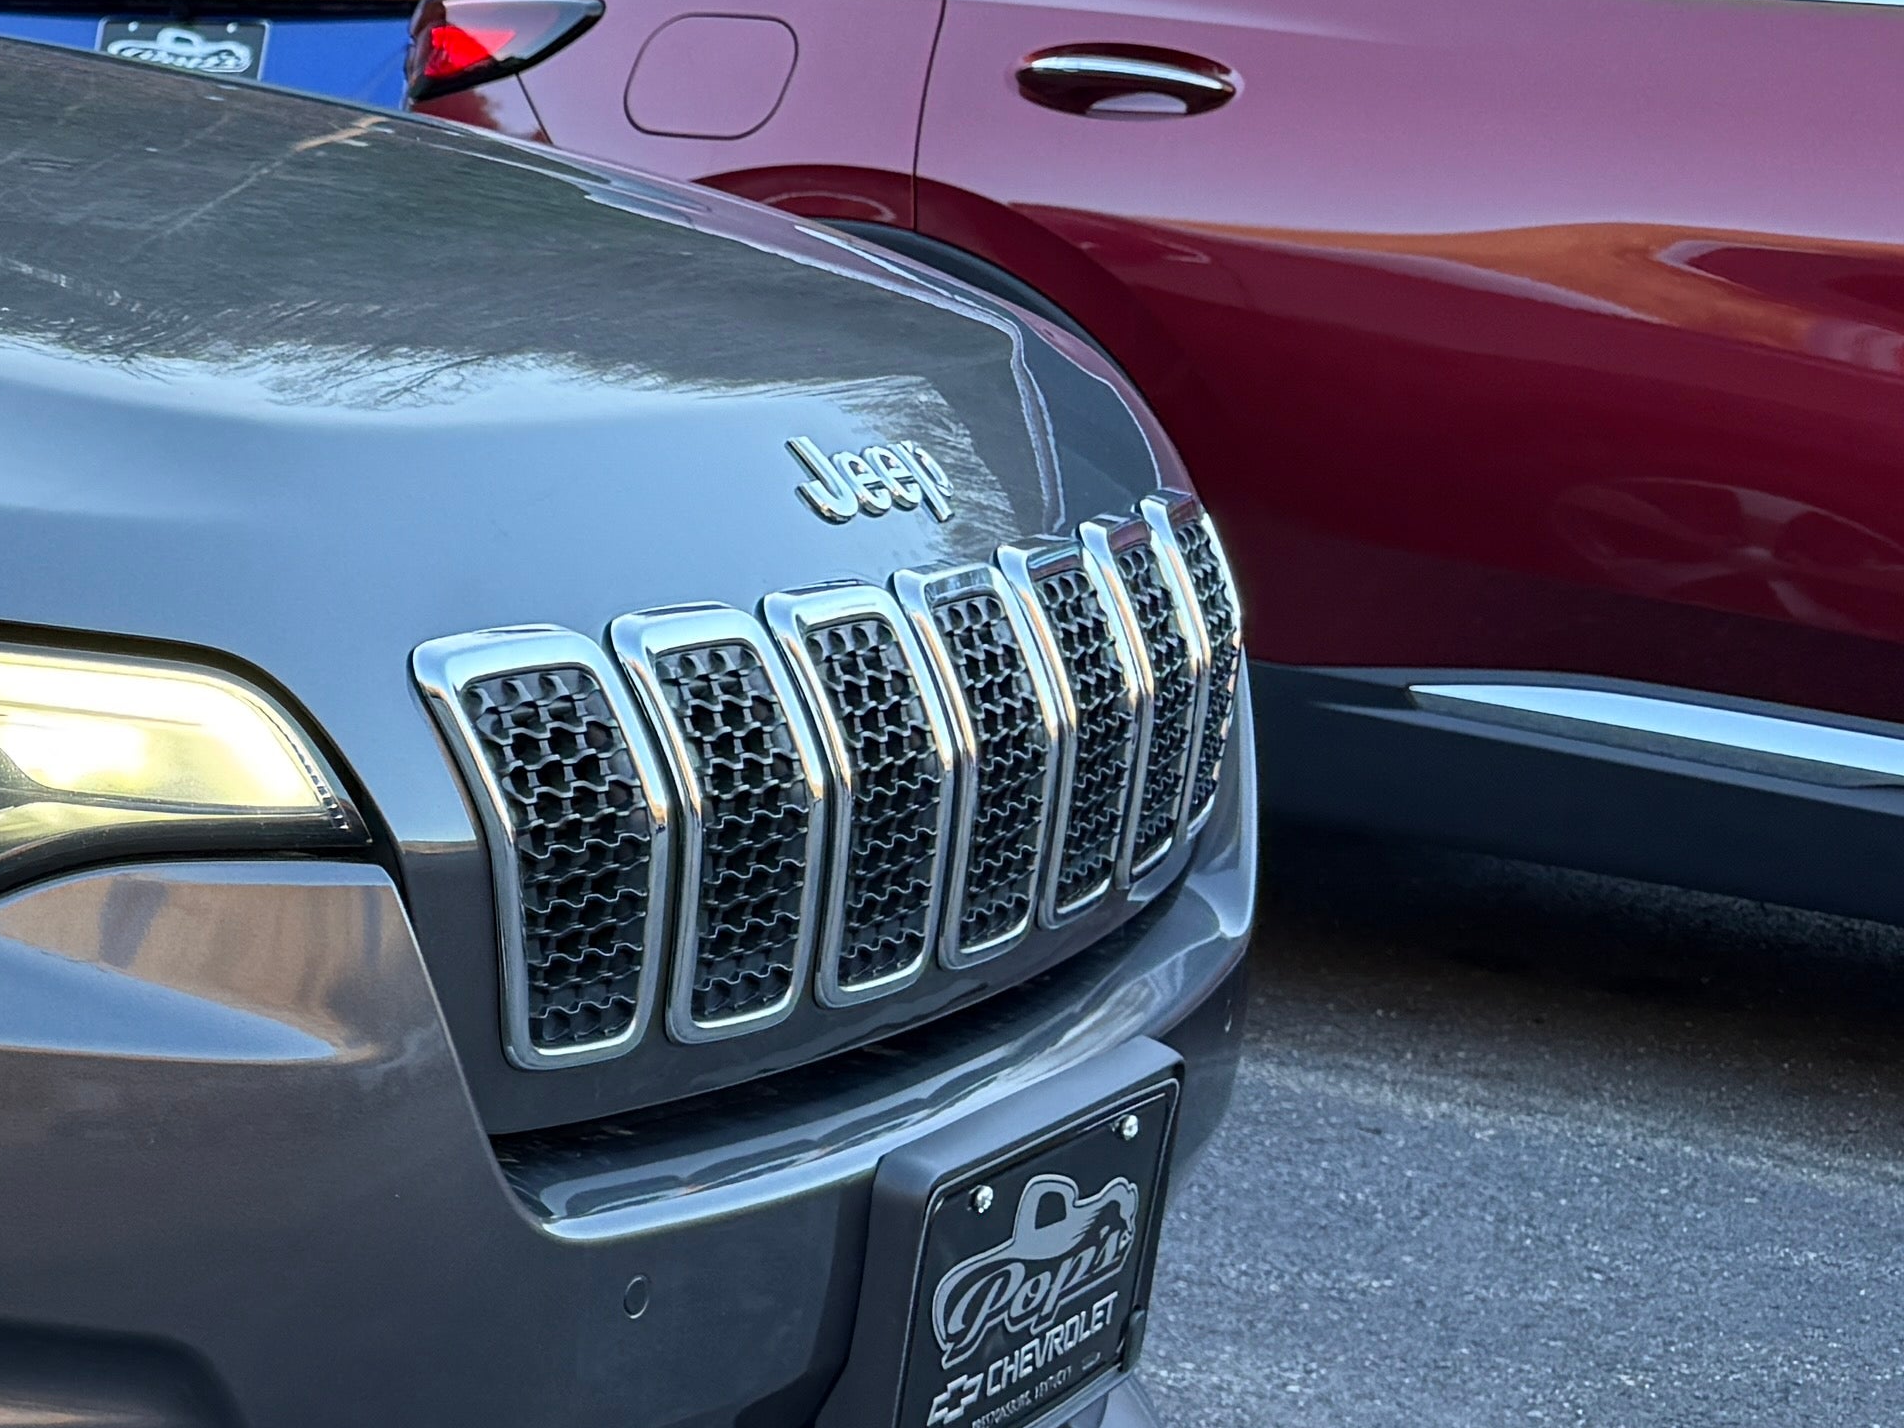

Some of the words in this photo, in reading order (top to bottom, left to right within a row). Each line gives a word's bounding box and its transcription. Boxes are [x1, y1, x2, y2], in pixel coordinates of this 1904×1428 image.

[784, 436, 955, 524] Jeep
[946, 1225, 1125, 1350] Pop's
[986, 1290, 1119, 1398] CHEVROLET
